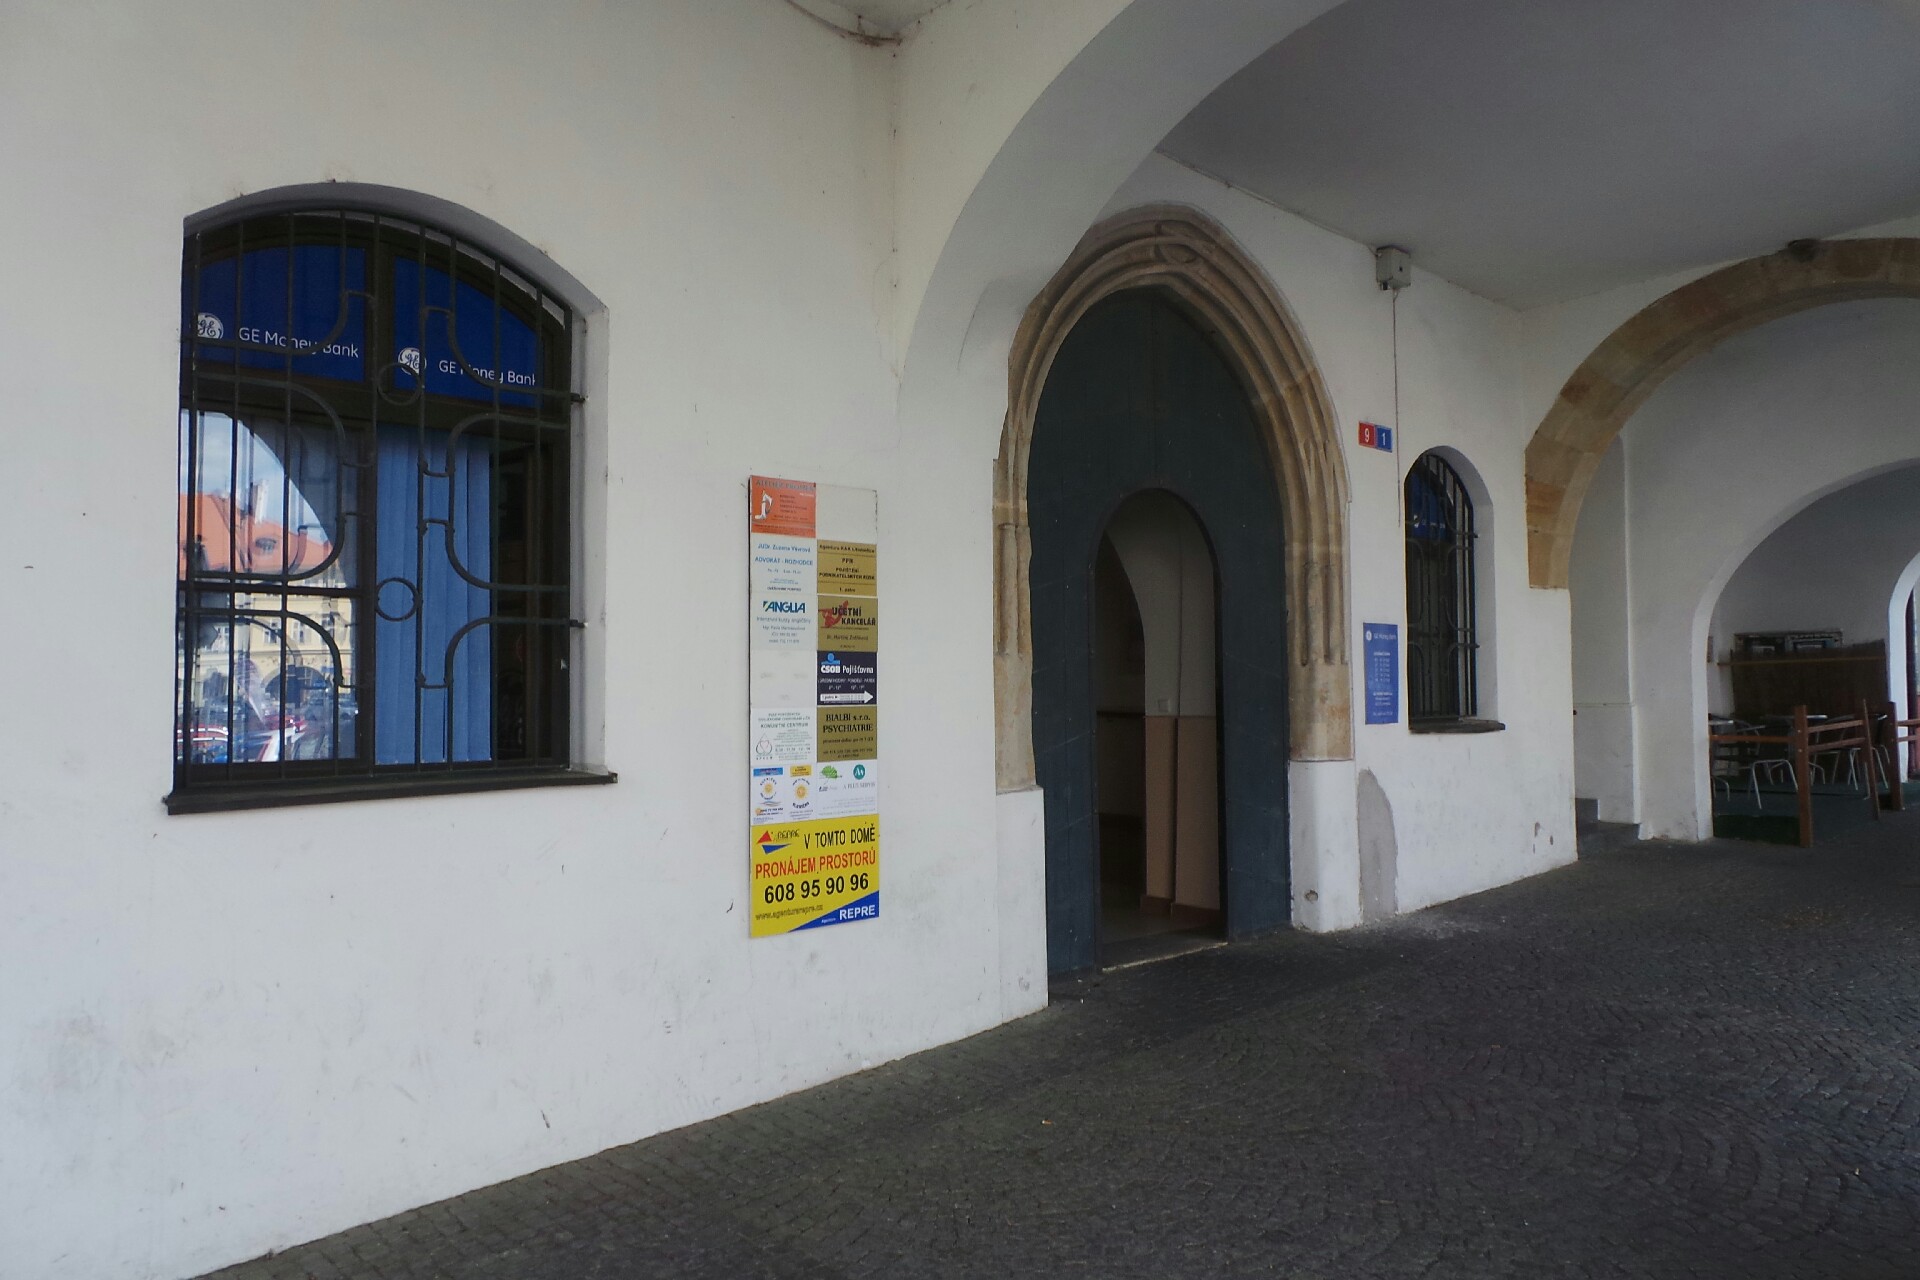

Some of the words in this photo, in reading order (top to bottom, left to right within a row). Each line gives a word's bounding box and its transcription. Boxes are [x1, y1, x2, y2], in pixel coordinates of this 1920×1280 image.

[238, 327, 260, 343] GE
[438, 360, 456, 374] GE
[1364, 427, 1370, 443] 9
[1382, 432, 1386, 446] 1
[764, 600, 806, 614] ANGLIA
[823, 724, 874, 733] PSYCHIATRIE
[803, 833, 811, 849] V
[815, 830, 846, 849] TOMTO
[850, 823, 876, 844] DOMĚ
[755, 856, 816, 880] PRONÁJEM
[764, 882, 795, 904] 608
[801, 879, 821, 899] 95
[825, 876, 845, 895] 90
[850, 872, 869, 891] 96
[839, 904, 876, 921] REPRE
